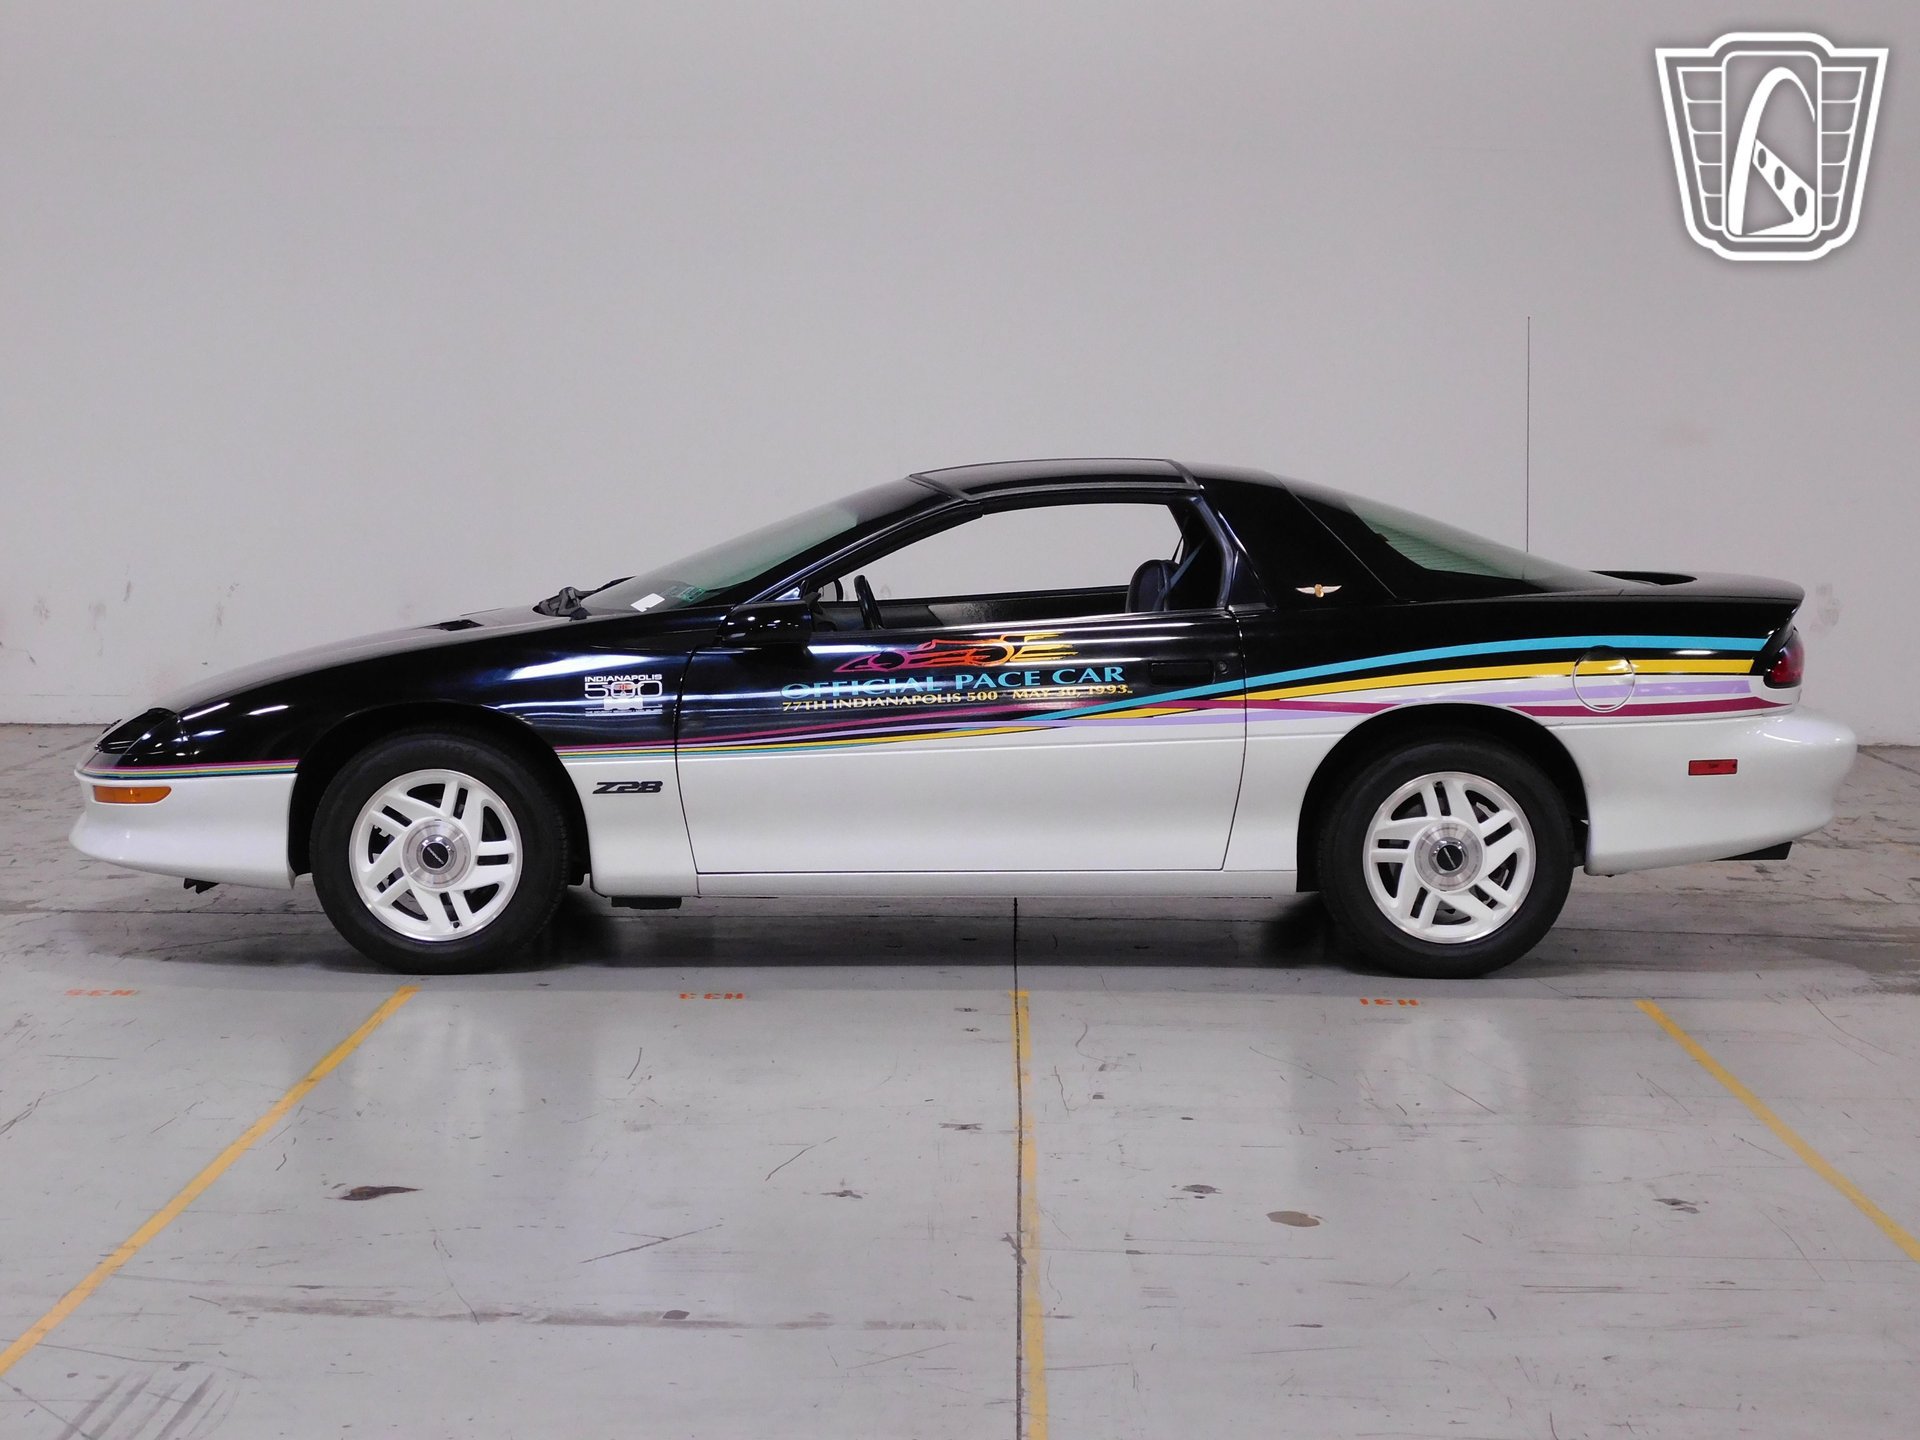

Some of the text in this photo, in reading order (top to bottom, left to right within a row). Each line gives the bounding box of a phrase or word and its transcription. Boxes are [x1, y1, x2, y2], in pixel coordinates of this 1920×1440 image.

[584, 674, 663, 683] INDIANAPOLIS
[781, 666, 1125, 699] OFFICIAL PACE CAR
[584, 681, 663, 699] 500
[782, 700, 827, 712] 77TH
[832, 692, 962, 709] INDIANAPOLIS
[966, 690, 998, 702] 500
[1012, 689, 1050, 699] MAY
[592, 780, 664, 795] Z28
